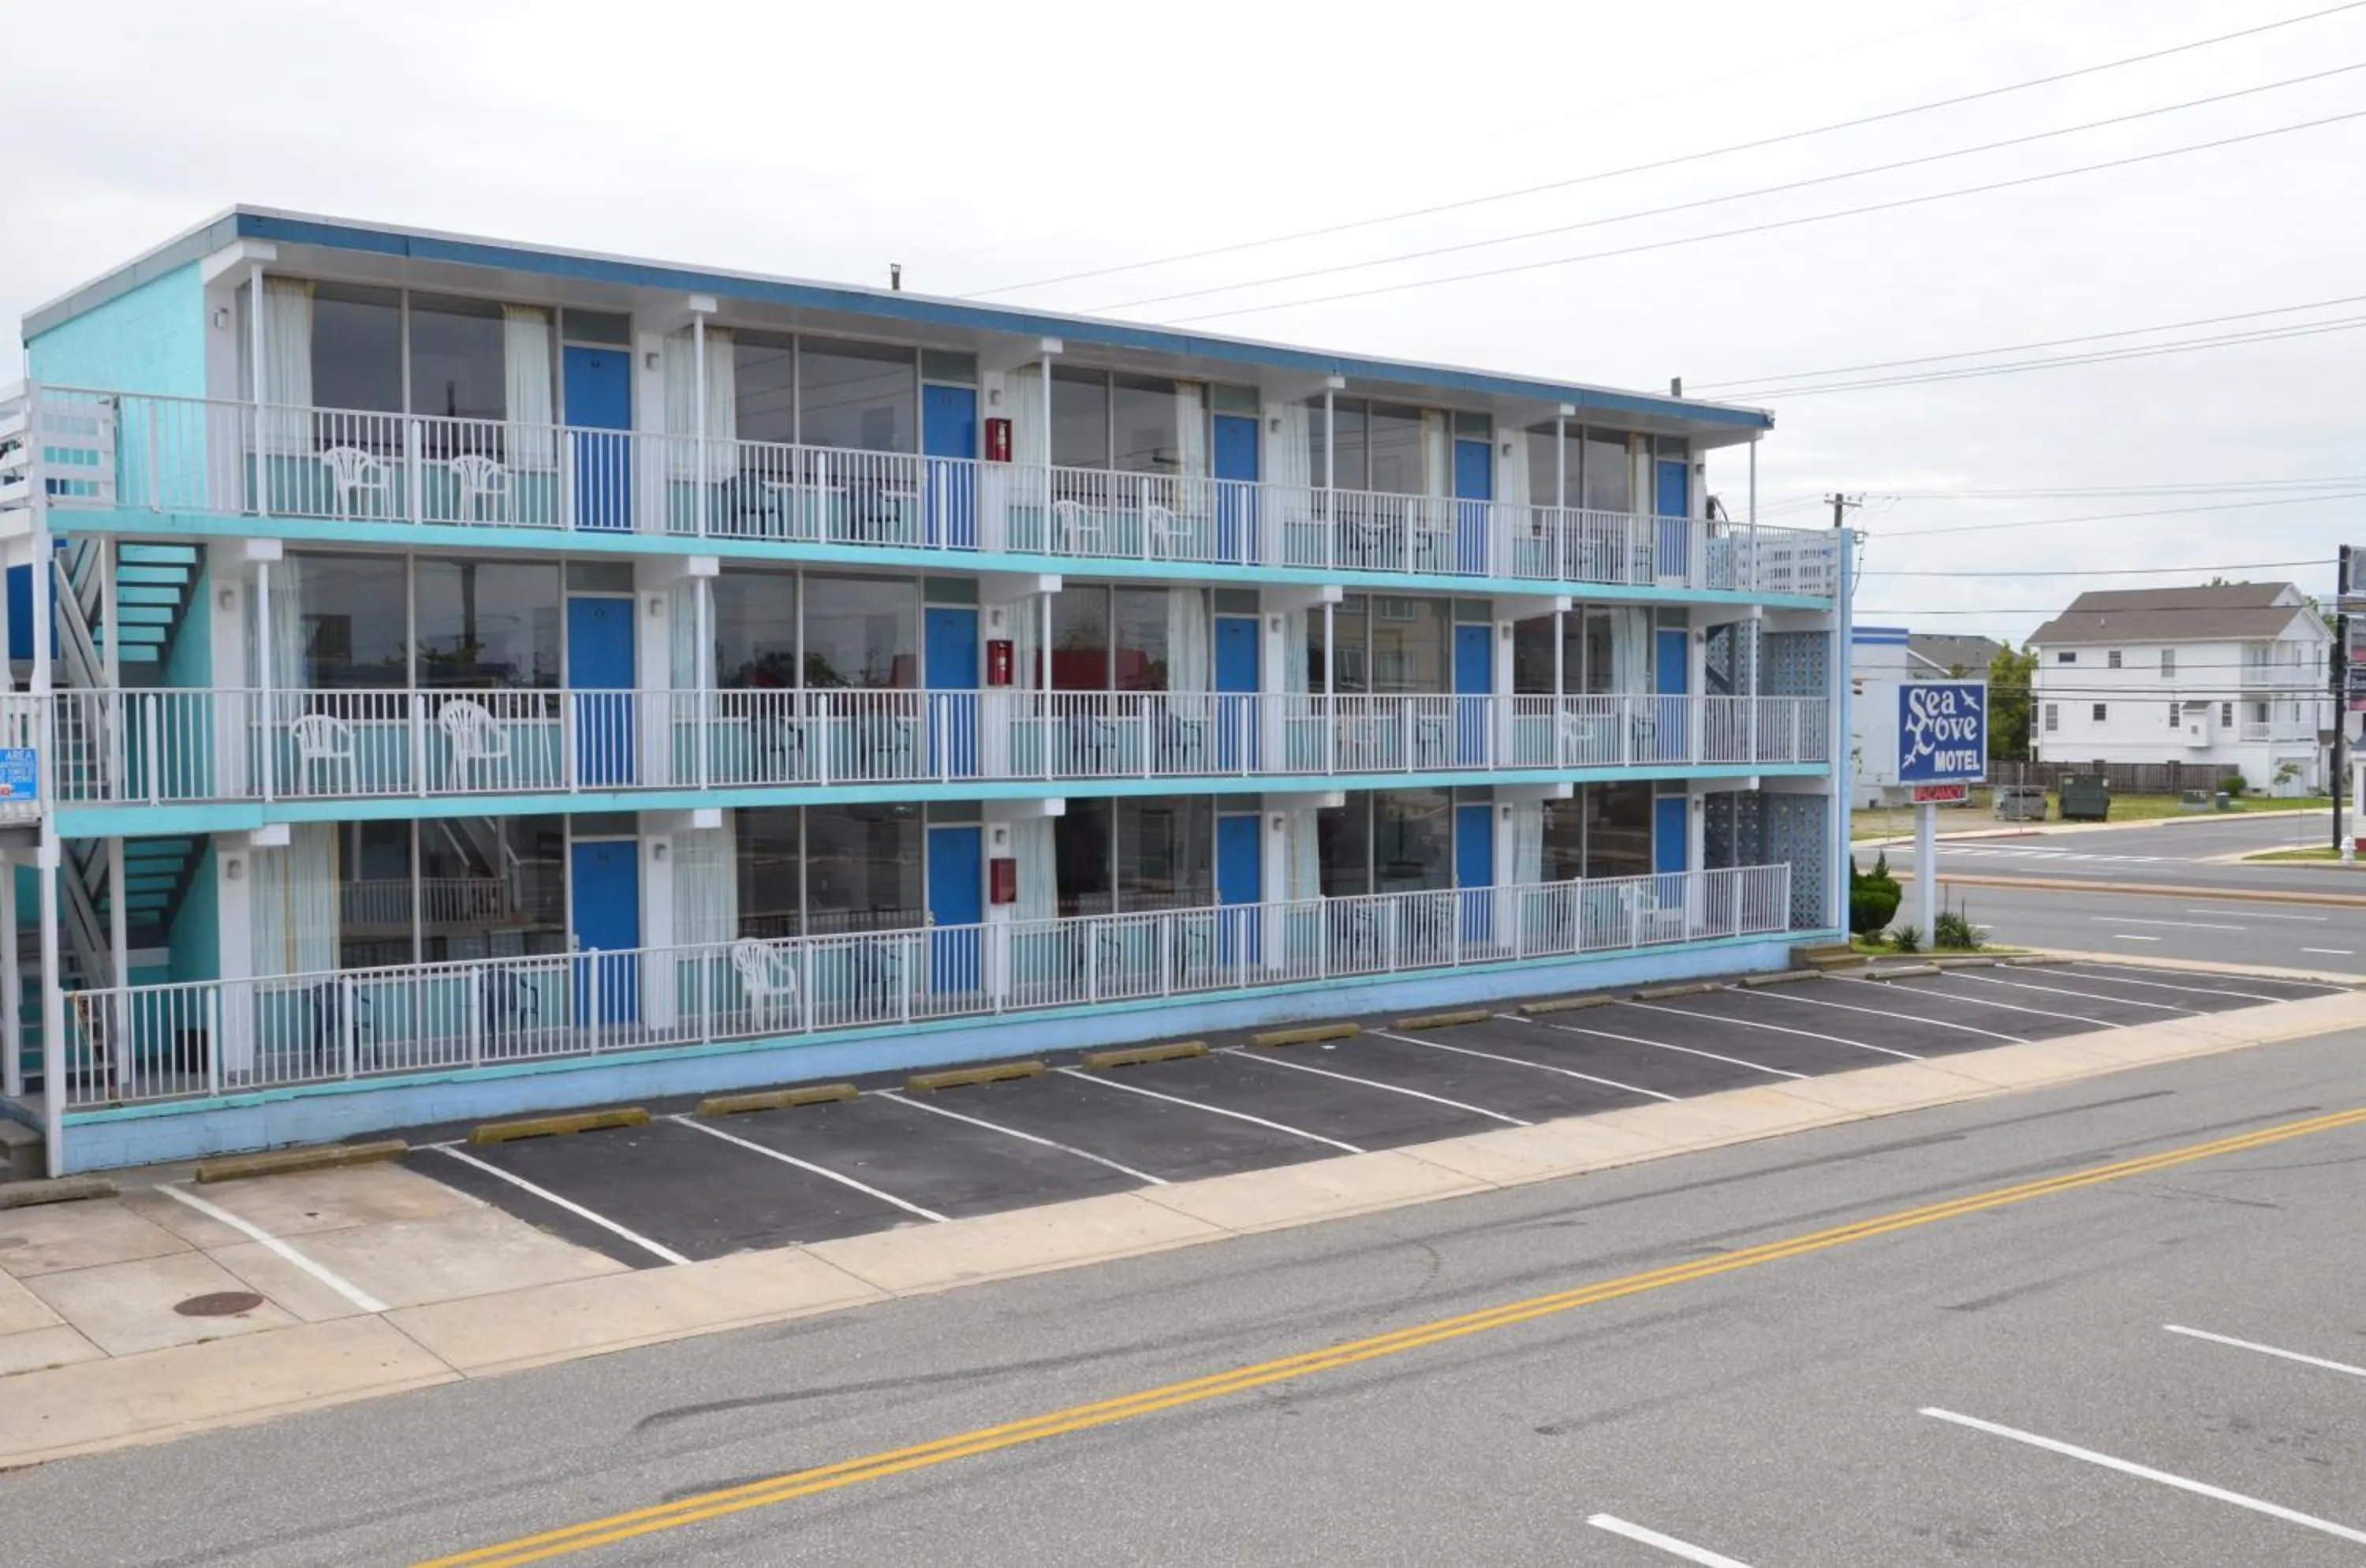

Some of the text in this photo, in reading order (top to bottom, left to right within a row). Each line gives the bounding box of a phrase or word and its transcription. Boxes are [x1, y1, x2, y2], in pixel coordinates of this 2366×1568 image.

[1905, 689, 1957, 731] Sea
[1914, 716, 1978, 755] Cove
[1935, 750, 1980, 772] MOTEL
